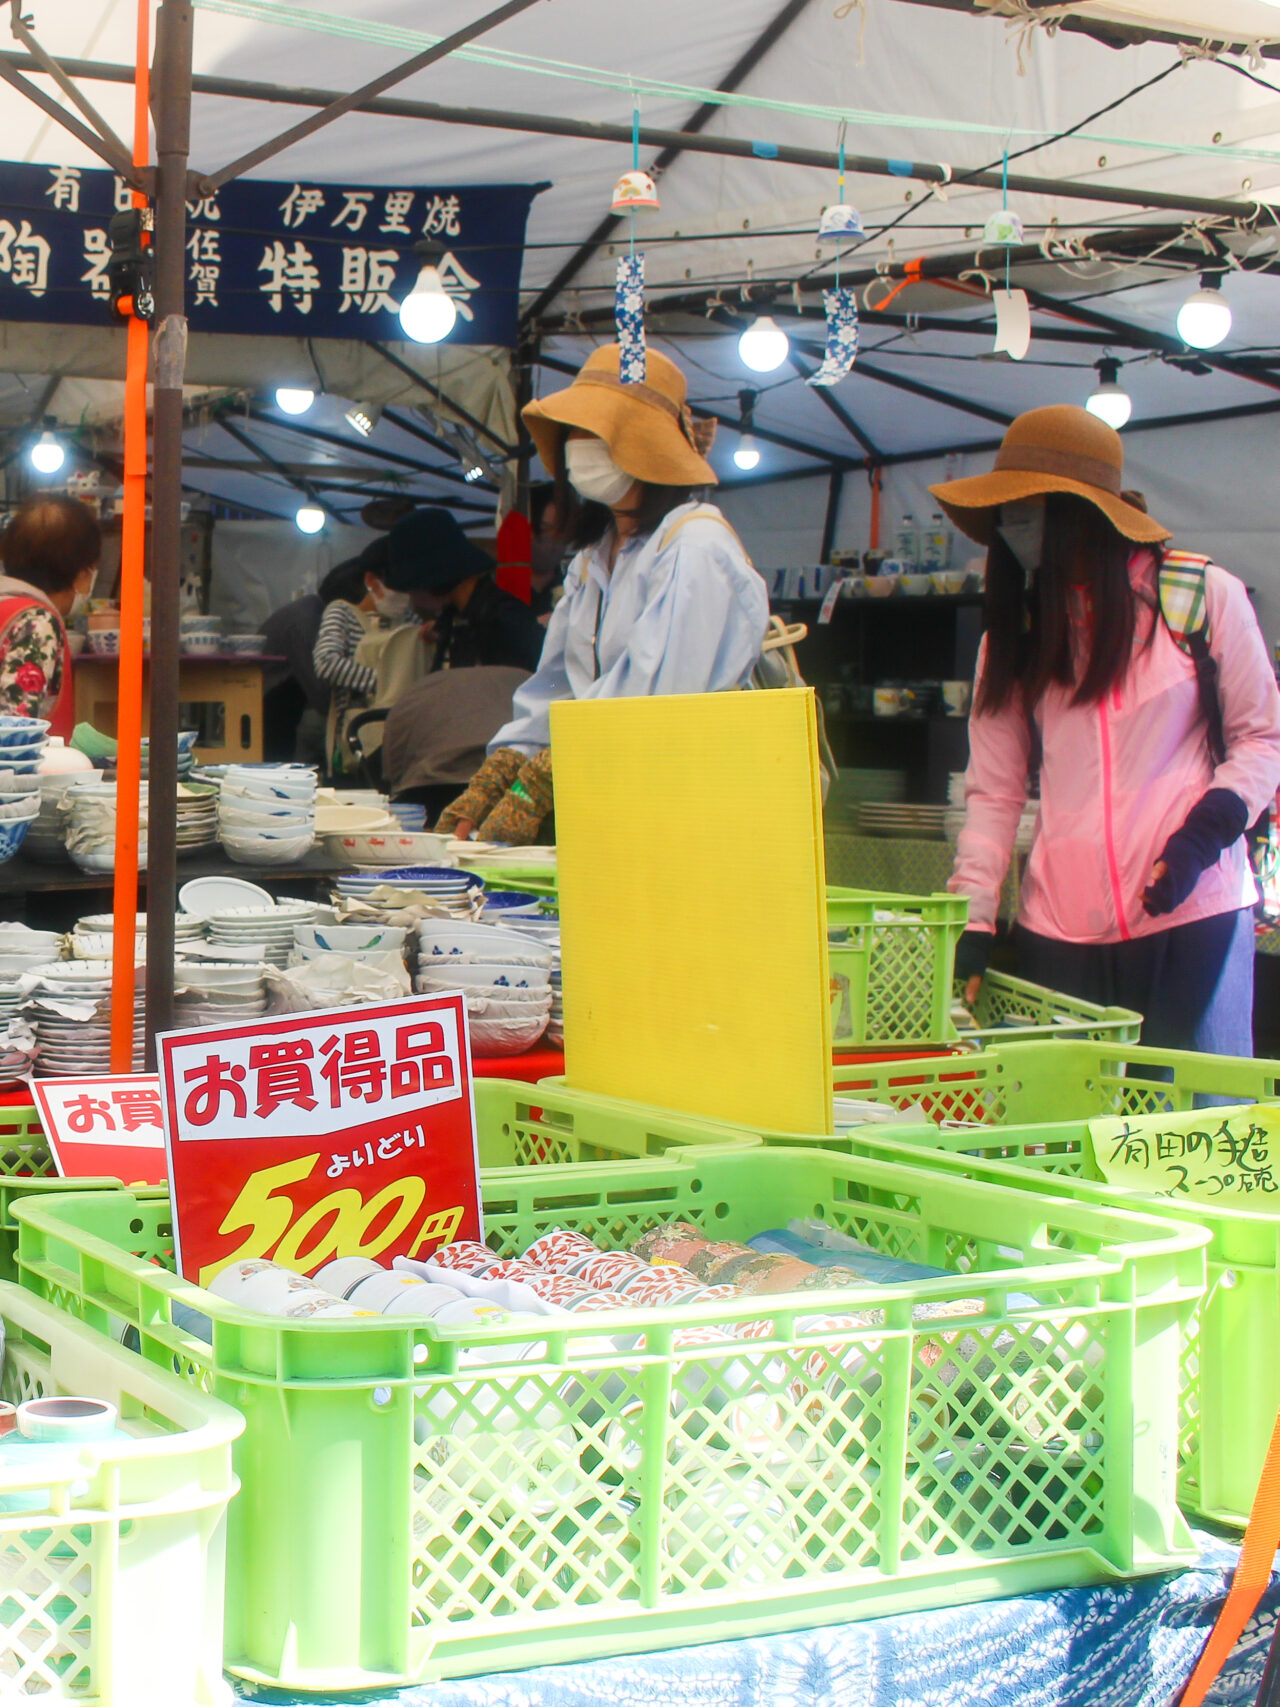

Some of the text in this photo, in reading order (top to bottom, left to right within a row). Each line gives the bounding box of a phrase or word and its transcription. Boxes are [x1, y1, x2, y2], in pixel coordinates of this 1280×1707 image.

[278, 183, 461, 237] 伊万里焼
[183, 1021, 455, 1126] お買得品
[326, 1124, 425, 1178] よりどり
[199, 1153, 465, 1289] 500円
